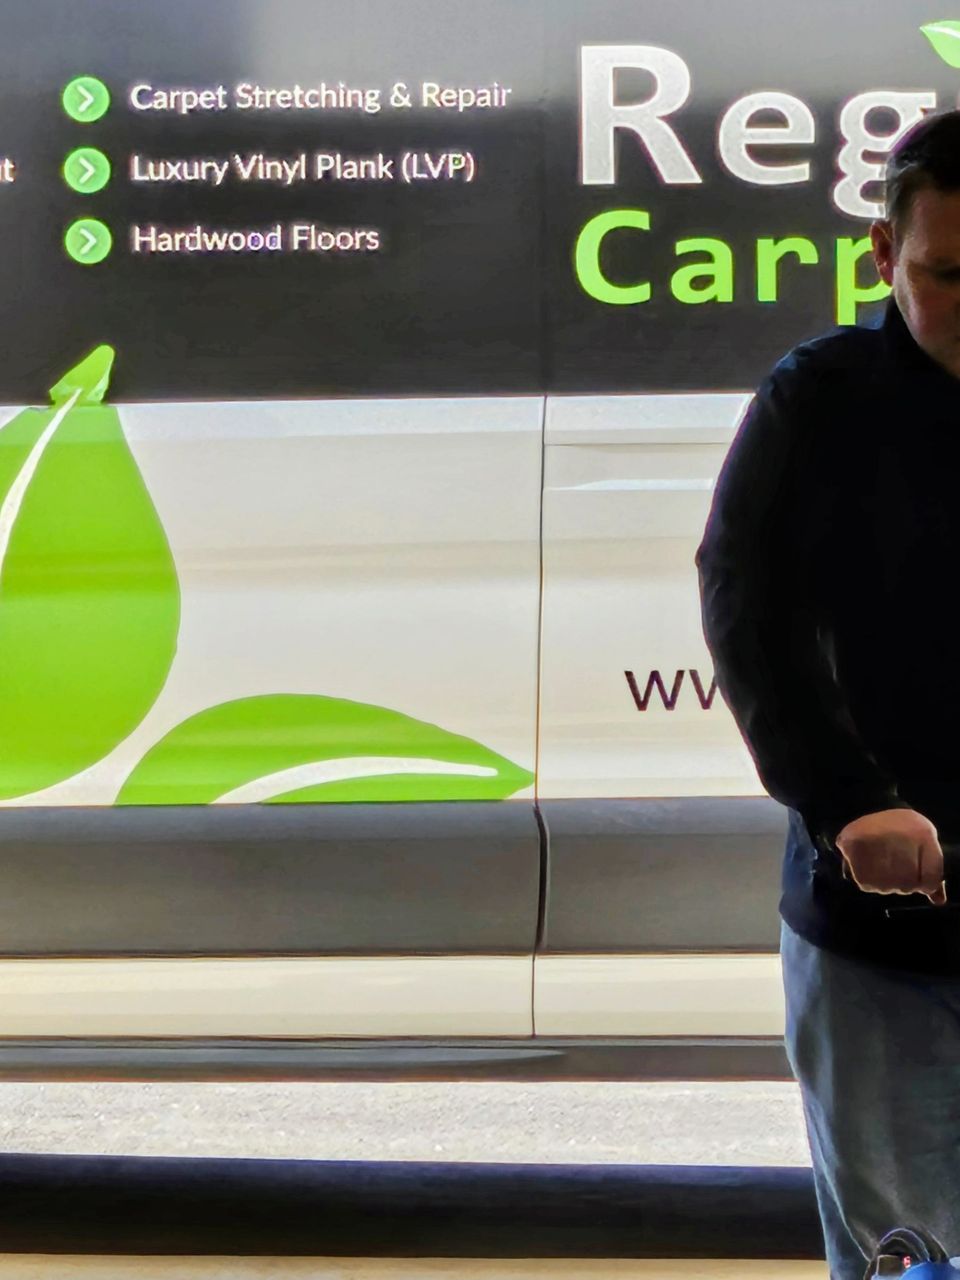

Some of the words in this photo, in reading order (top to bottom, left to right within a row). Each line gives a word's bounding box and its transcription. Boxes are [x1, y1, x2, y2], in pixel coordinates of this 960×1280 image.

[130, 84, 227, 113] Carpet
[235, 82, 381, 112] Stretching
[389, 83, 412, 107] &
[421, 81, 512, 111] Repair
[131, 154, 229, 185] Luxury
[235, 153, 305, 184] Vinyl
[315, 153, 394, 181] Plank
[401, 152, 475, 182] (LVP)
[133, 224, 282, 252] Hardwood
[292, 223, 380, 251] Floors
[575, 209, 892, 326] Carp
